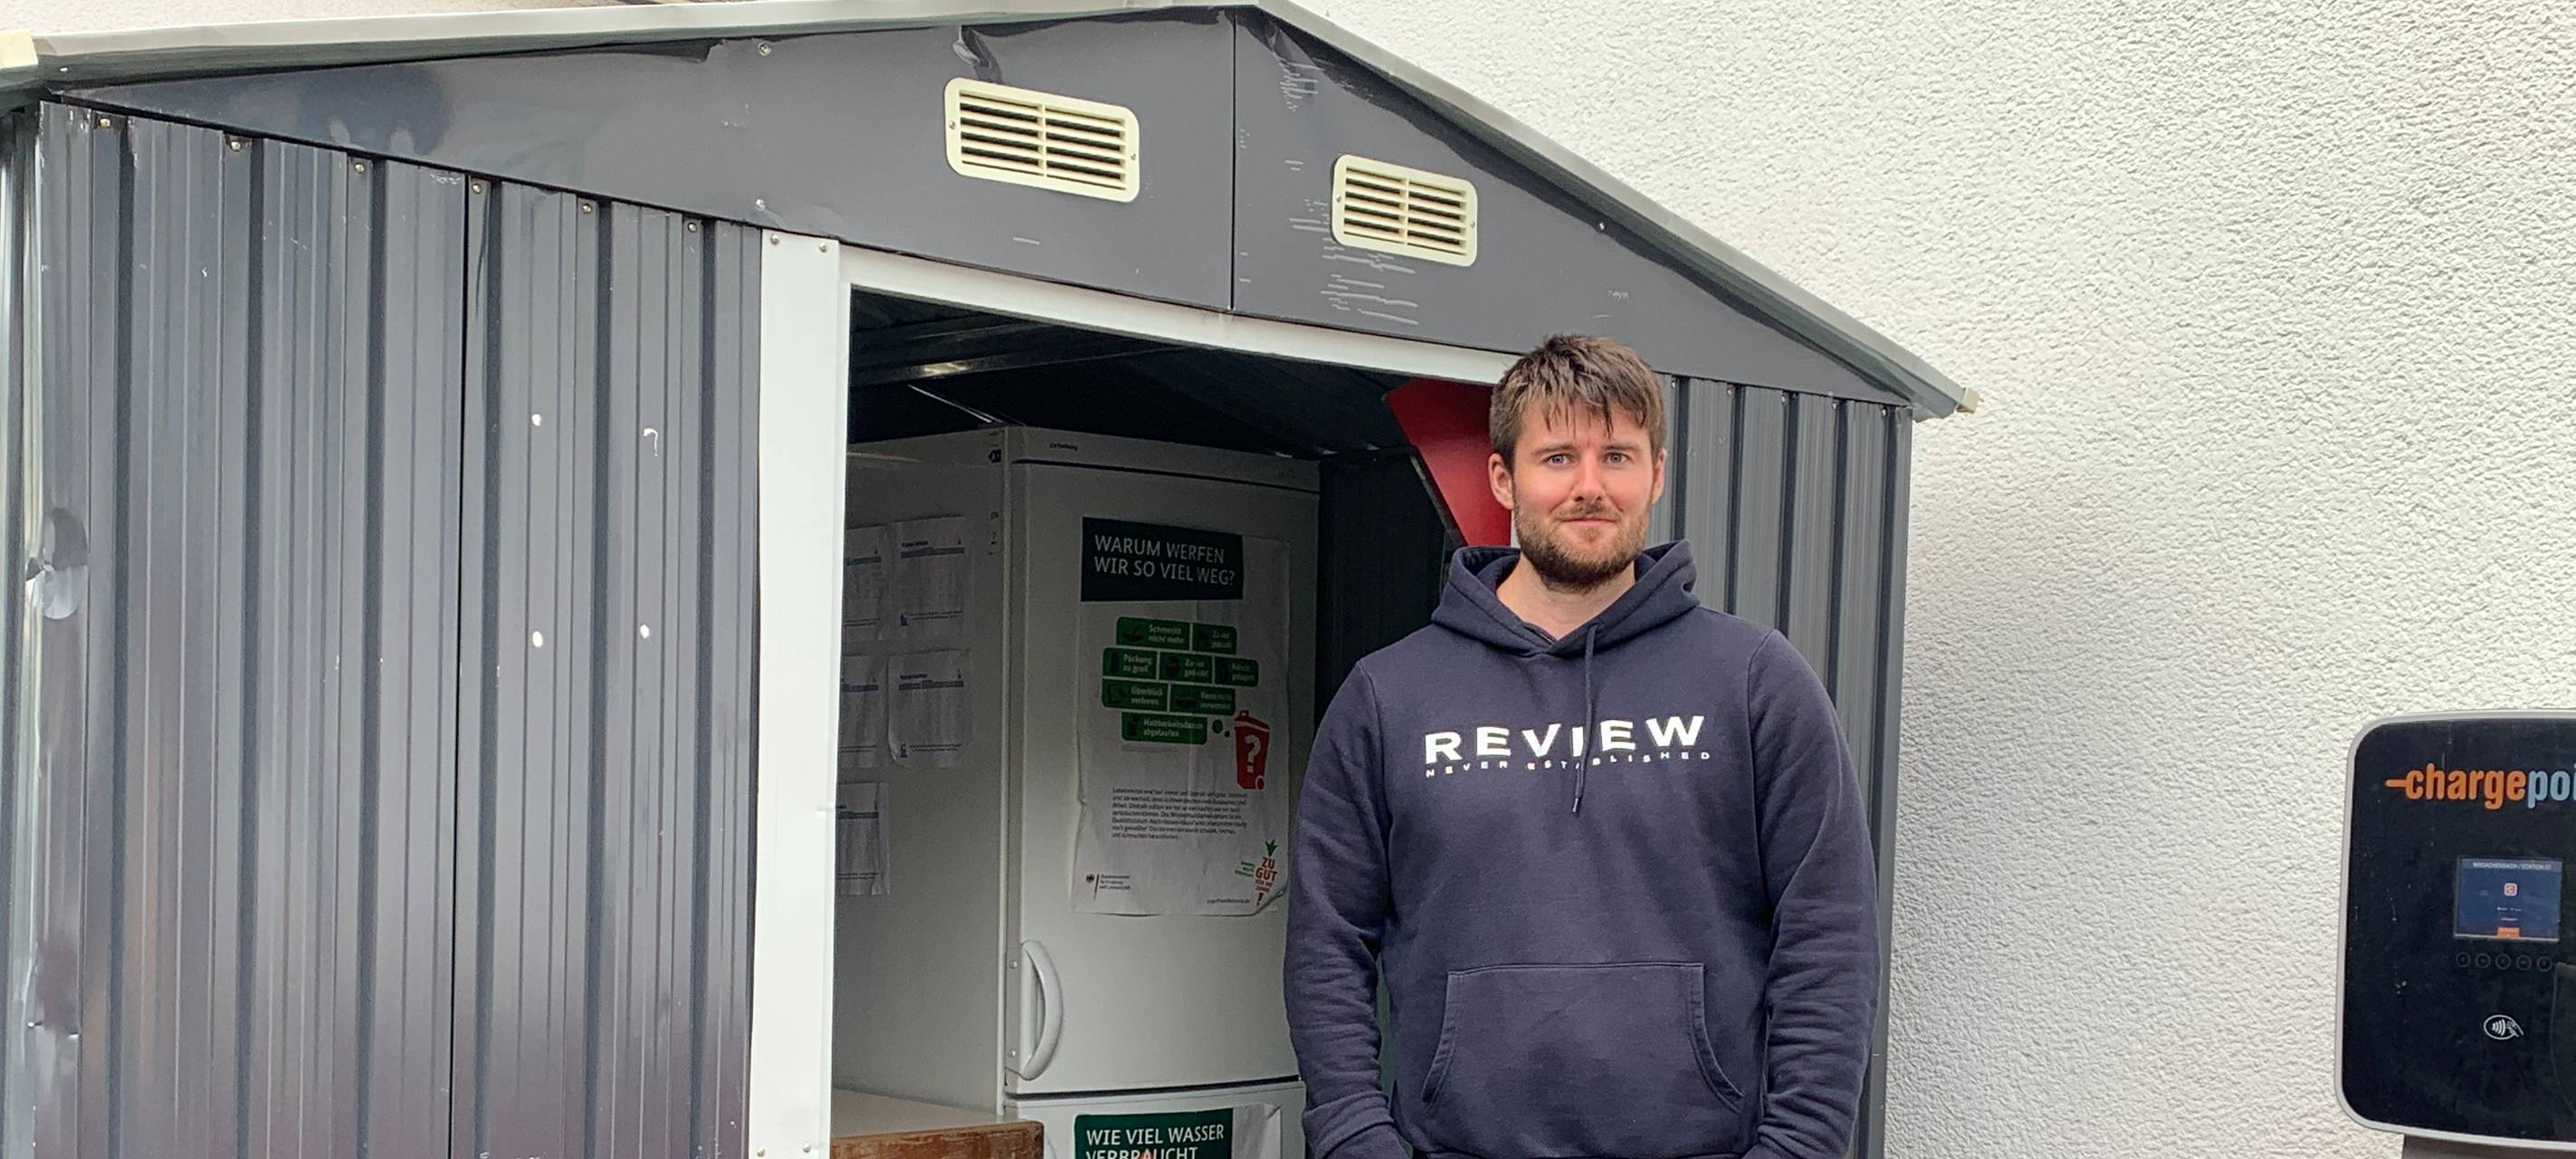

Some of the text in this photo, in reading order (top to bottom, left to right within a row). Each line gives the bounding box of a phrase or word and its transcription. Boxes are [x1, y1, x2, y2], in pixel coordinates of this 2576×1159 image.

[1094, 534, 1225, 564] WARUM WERFEN
[1093, 556, 1236, 586] WIR SO VIEL WEG?
[1122, 654, 1152, 666] Packung
[1425, 715, 1704, 764] REVIEW
[1426, 761, 1508, 778] NEVER
[1262, 857, 1275, 869] ZU
[1255, 867, 1278, 881] GUT
[1086, 1124, 1224, 1145] WIE VIEL WASSER
